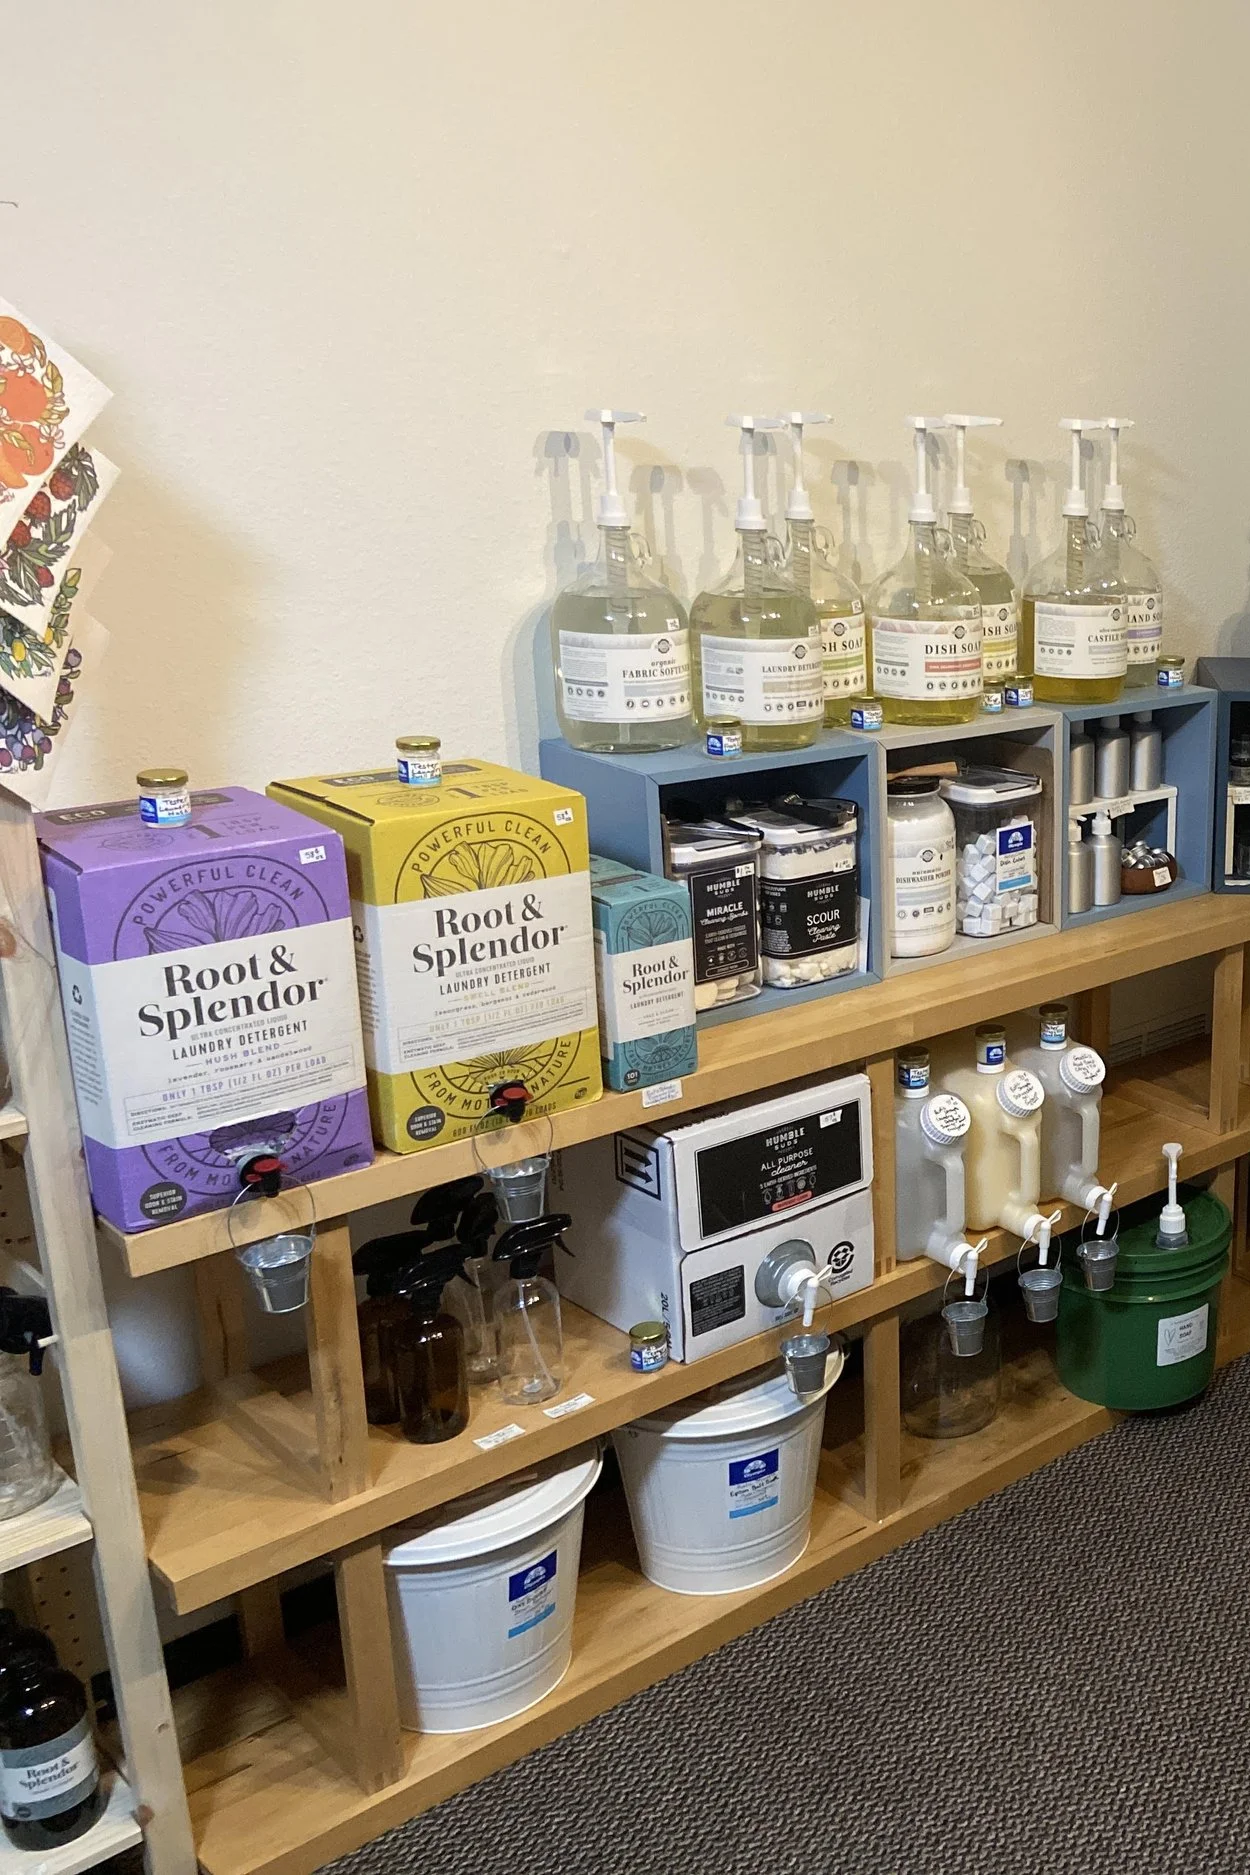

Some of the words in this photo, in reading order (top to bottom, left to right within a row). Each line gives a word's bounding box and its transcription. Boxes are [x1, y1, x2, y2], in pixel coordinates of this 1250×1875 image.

[925, 644, 957, 655] DISH
[1088, 634, 1118, 643] CASTILE
[762, 665, 796, 673] LAUNDRY
[413, 820, 495, 872] POWERFUL
[505, 820, 551, 855] CLEAN
[133, 866, 234, 925] POWERFUL
[246, 864, 304, 900] CLEAN
[706, 878, 741, 893] HUMBLE
[714, 886, 735, 896] SUDS
[807, 883, 840, 898] HUMBLE
[814, 893, 834, 901] SUDS
[433, 901, 514, 938] Root
[521, 893, 543, 921] &
[706, 901, 744, 918] MIRACLE
[806, 909, 841, 926] SCOUR
[807, 923, 842, 936] Cleaning
[812, 932, 837, 943] Paste
[412, 925, 565, 977] Splendor
[163, 953, 262, 998] Root
[269, 944, 297, 975] &
[475, 960, 517, 974] CONCENTRATED
[517, 956, 535, 965] LIQUID
[632, 959, 666, 978] Root
[669, 956, 679, 970] &
[439, 976, 490, 995] LAUNDRY
[494, 963, 551, 985] DETERGENT
[622, 969, 689, 995] Splendor
[138, 979, 324, 1041] Splendor
[630, 997, 655, 1010] LAUNDRY
[173, 1037, 232, 1060] LAUNDRY
[239, 1020, 308, 1046] DETERGENT
[206, 1053, 237, 1065] HUSH
[243, 1043, 280, 1057] BLEND
[530, 1040, 571, 1094] NATURE
[627, 1071, 639, 1080] 101
[163, 1090, 187, 1102] ONLY
[200, 1082, 224, 1095] TBSP
[285, 1063, 301, 1074] PER
[305, 1056, 327, 1070] LOAD
[424, 1072, 457, 1105] FROM
[291, 1104, 337, 1163] NATURE
[766, 1127, 806, 1147] HUMBLE
[774, 1139, 798, 1151] SUDS
[158, 1145, 199, 1181] FROM
[760, 1162, 775, 1172] ALL
[778, 1147, 814, 1166] PURPOSE
[771, 1159, 808, 1177] cleaner
[19, 1761, 80, 1790] Splendor
[27, 1764, 58, 1779] Root
[61, 1757, 70, 1767] &
